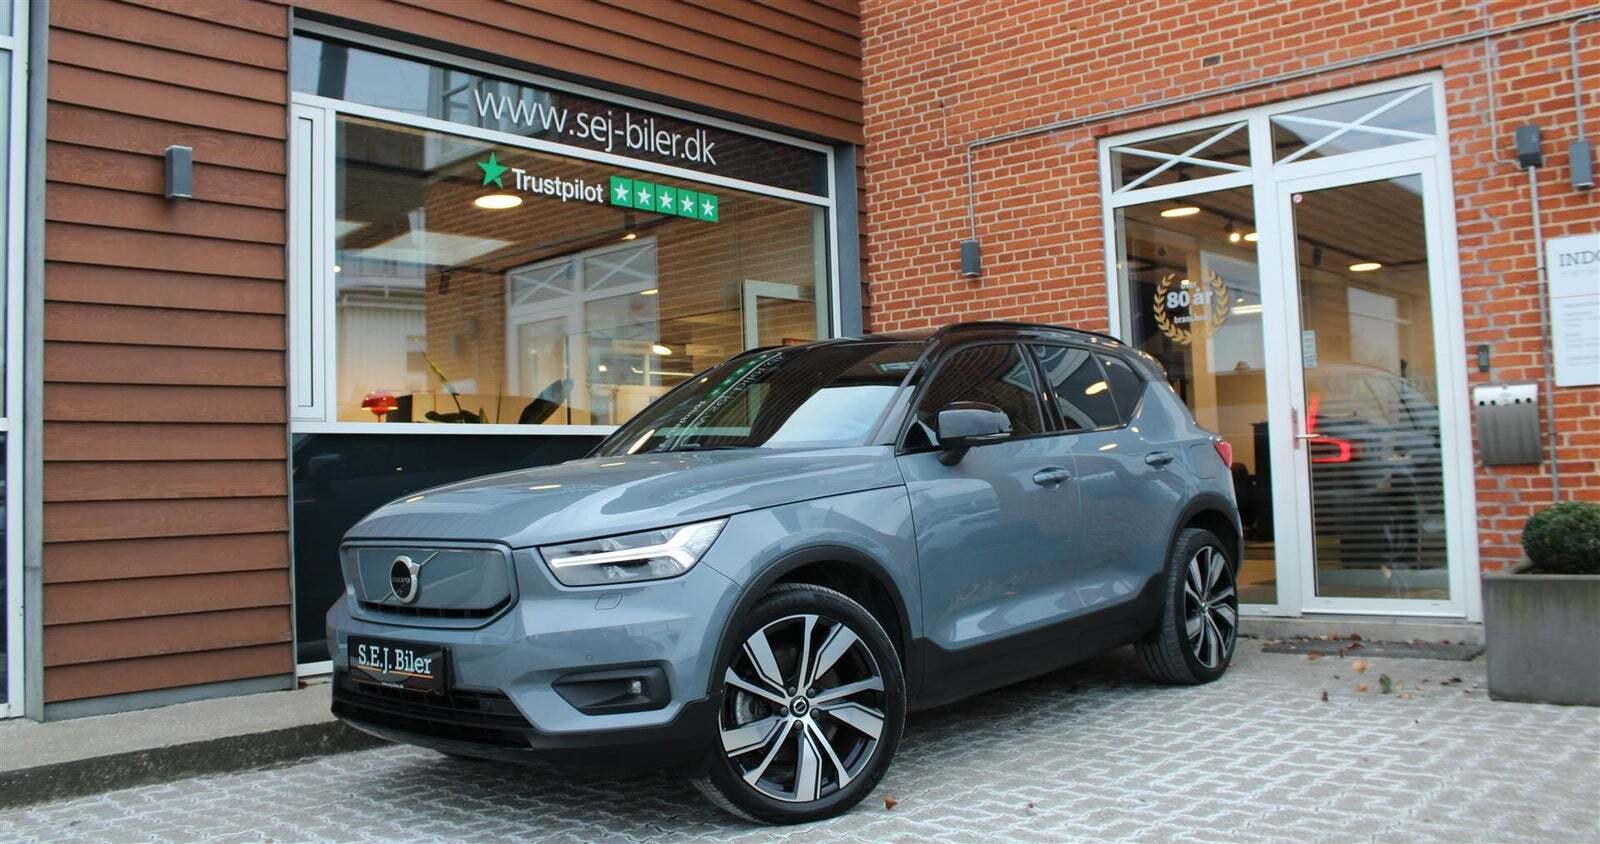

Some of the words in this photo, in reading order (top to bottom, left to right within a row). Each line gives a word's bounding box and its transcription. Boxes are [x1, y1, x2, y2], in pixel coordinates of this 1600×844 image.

[474, 89, 716, 165] www.sej-biler.dk
[511, 168, 603, 203] Trustpilot
[1166, 291, 1190, 308] 80
[358, 644, 392, 674] S.E.J.
[395, 649, 432, 674] Biler
